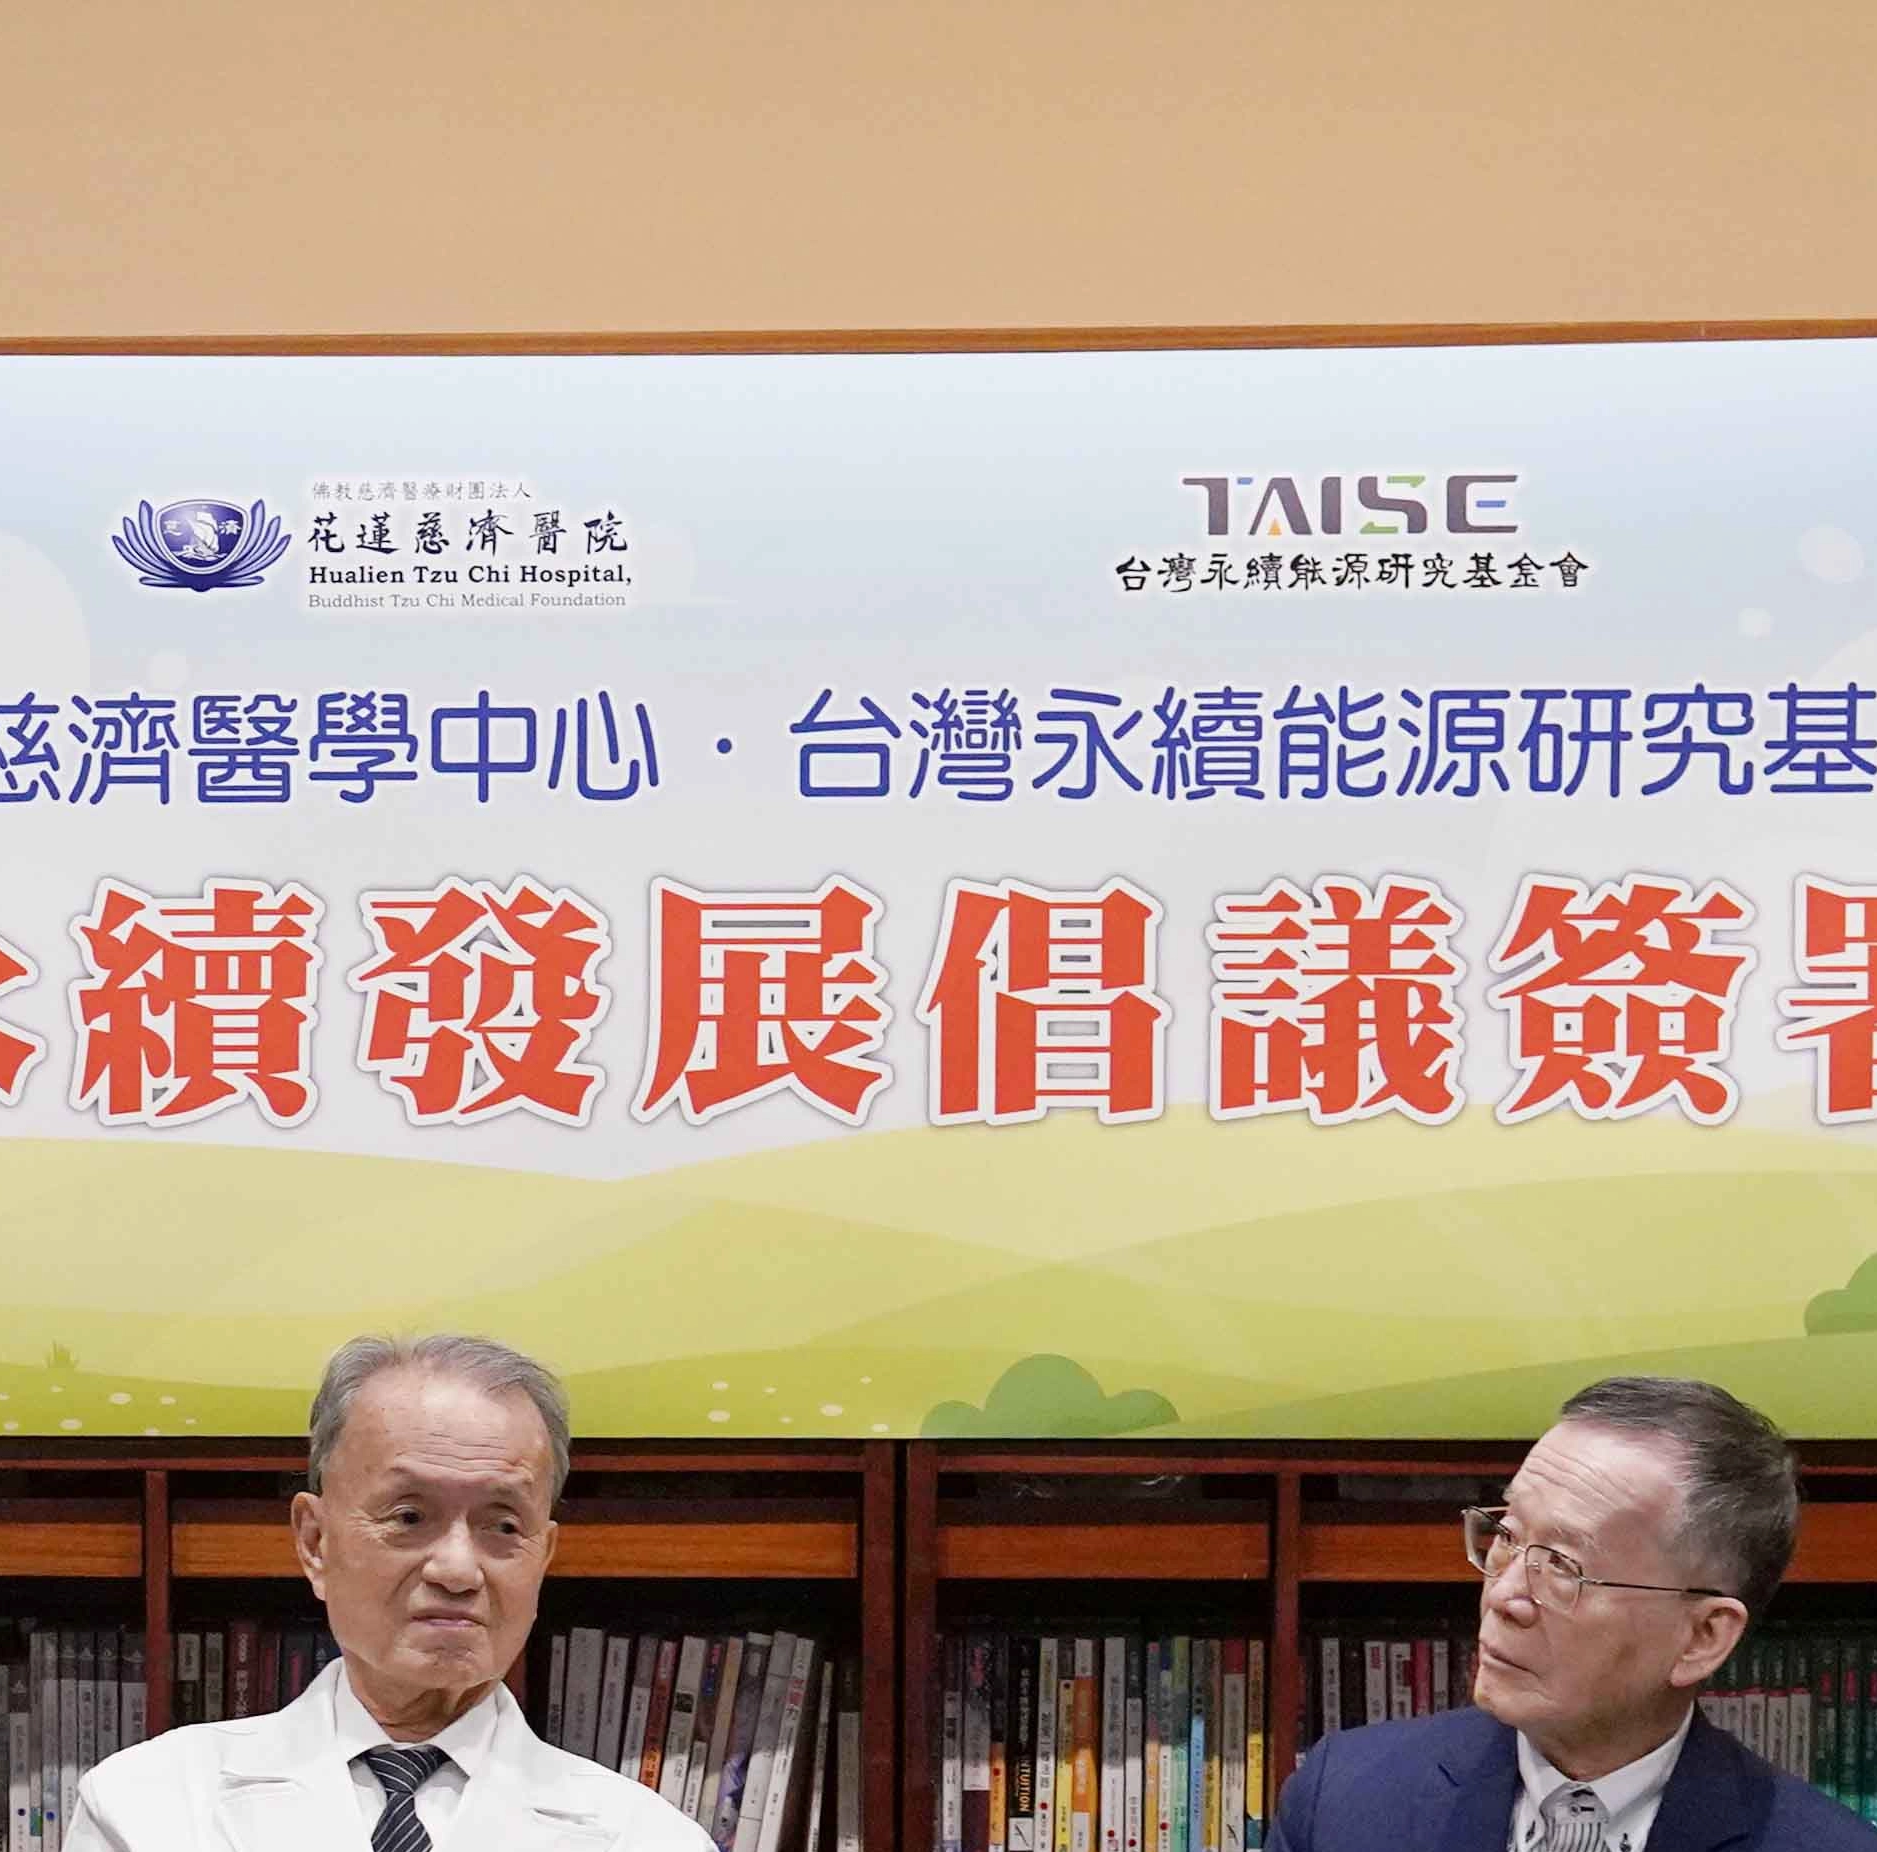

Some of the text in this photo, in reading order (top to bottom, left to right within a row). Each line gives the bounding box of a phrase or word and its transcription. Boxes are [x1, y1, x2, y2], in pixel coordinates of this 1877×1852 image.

[312, 481, 531, 502] 佛教慈濟醫療財團法人
[1182, 474, 1518, 539] TAISE
[307, 508, 629, 556] 花蓮慈濟醫院
[309, 564, 633, 588] Hualien Tzu Chi Hospital,
[1115, 551, 1590, 593] 台灣永續能源研究基金會
[309, 593, 627, 608] Buddhist Tzu Chi Medical Foundation
